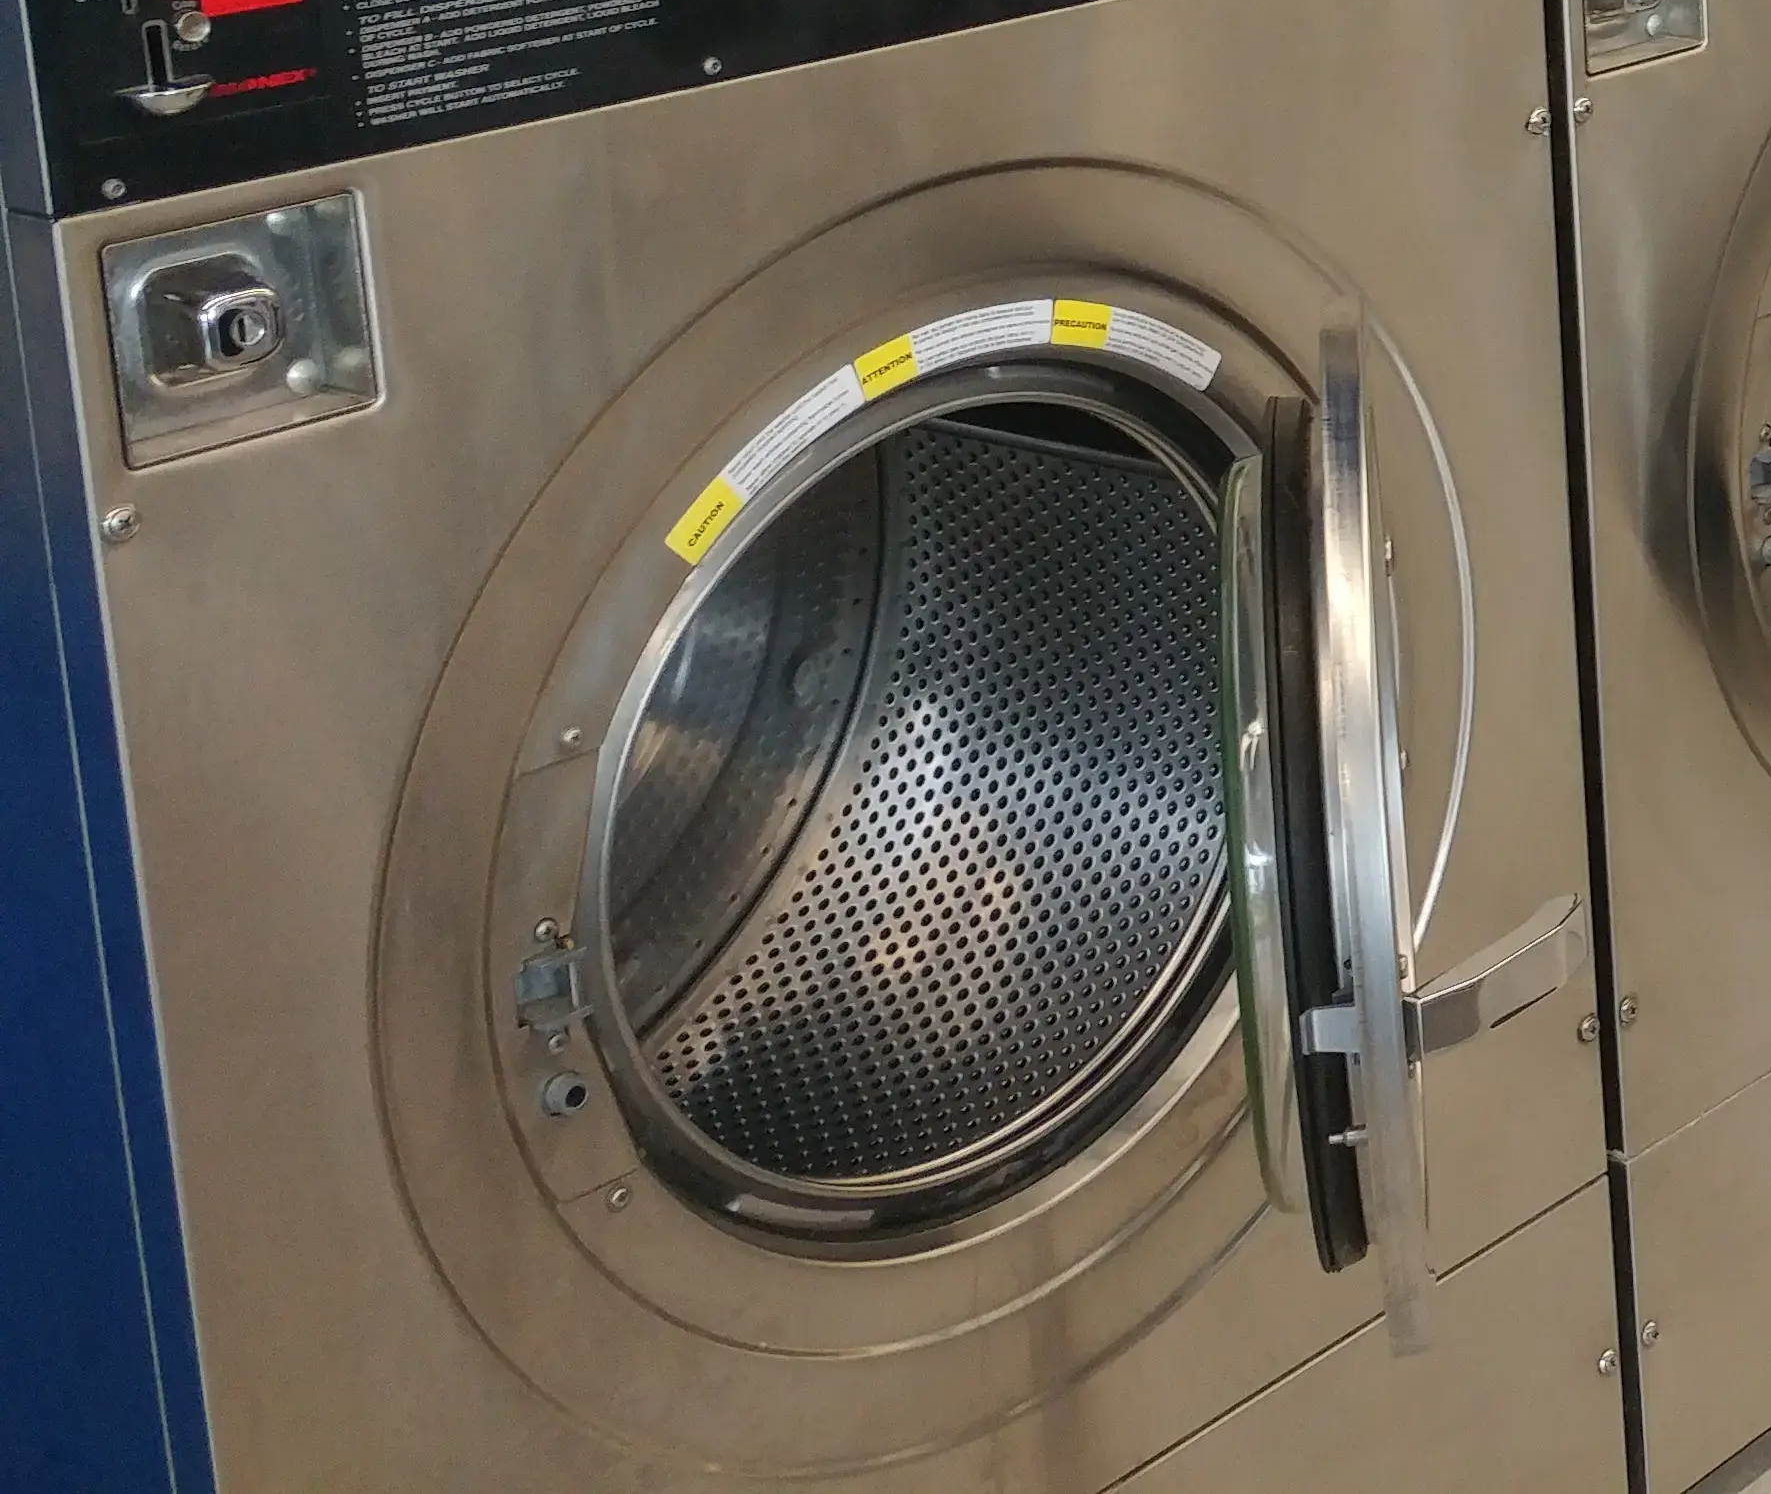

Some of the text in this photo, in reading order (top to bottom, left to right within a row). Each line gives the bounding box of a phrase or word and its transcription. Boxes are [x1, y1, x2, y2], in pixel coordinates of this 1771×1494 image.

[358, 14, 381, 25] TO
[383, 8, 420, 20] FILL
[367, 63, 490, 94] TO START WASHER
[1053, 318, 1108, 332] PRECAUTION
[862, 351, 913, 385] ATTENTION
[688, 501, 726, 547] CAUTION
